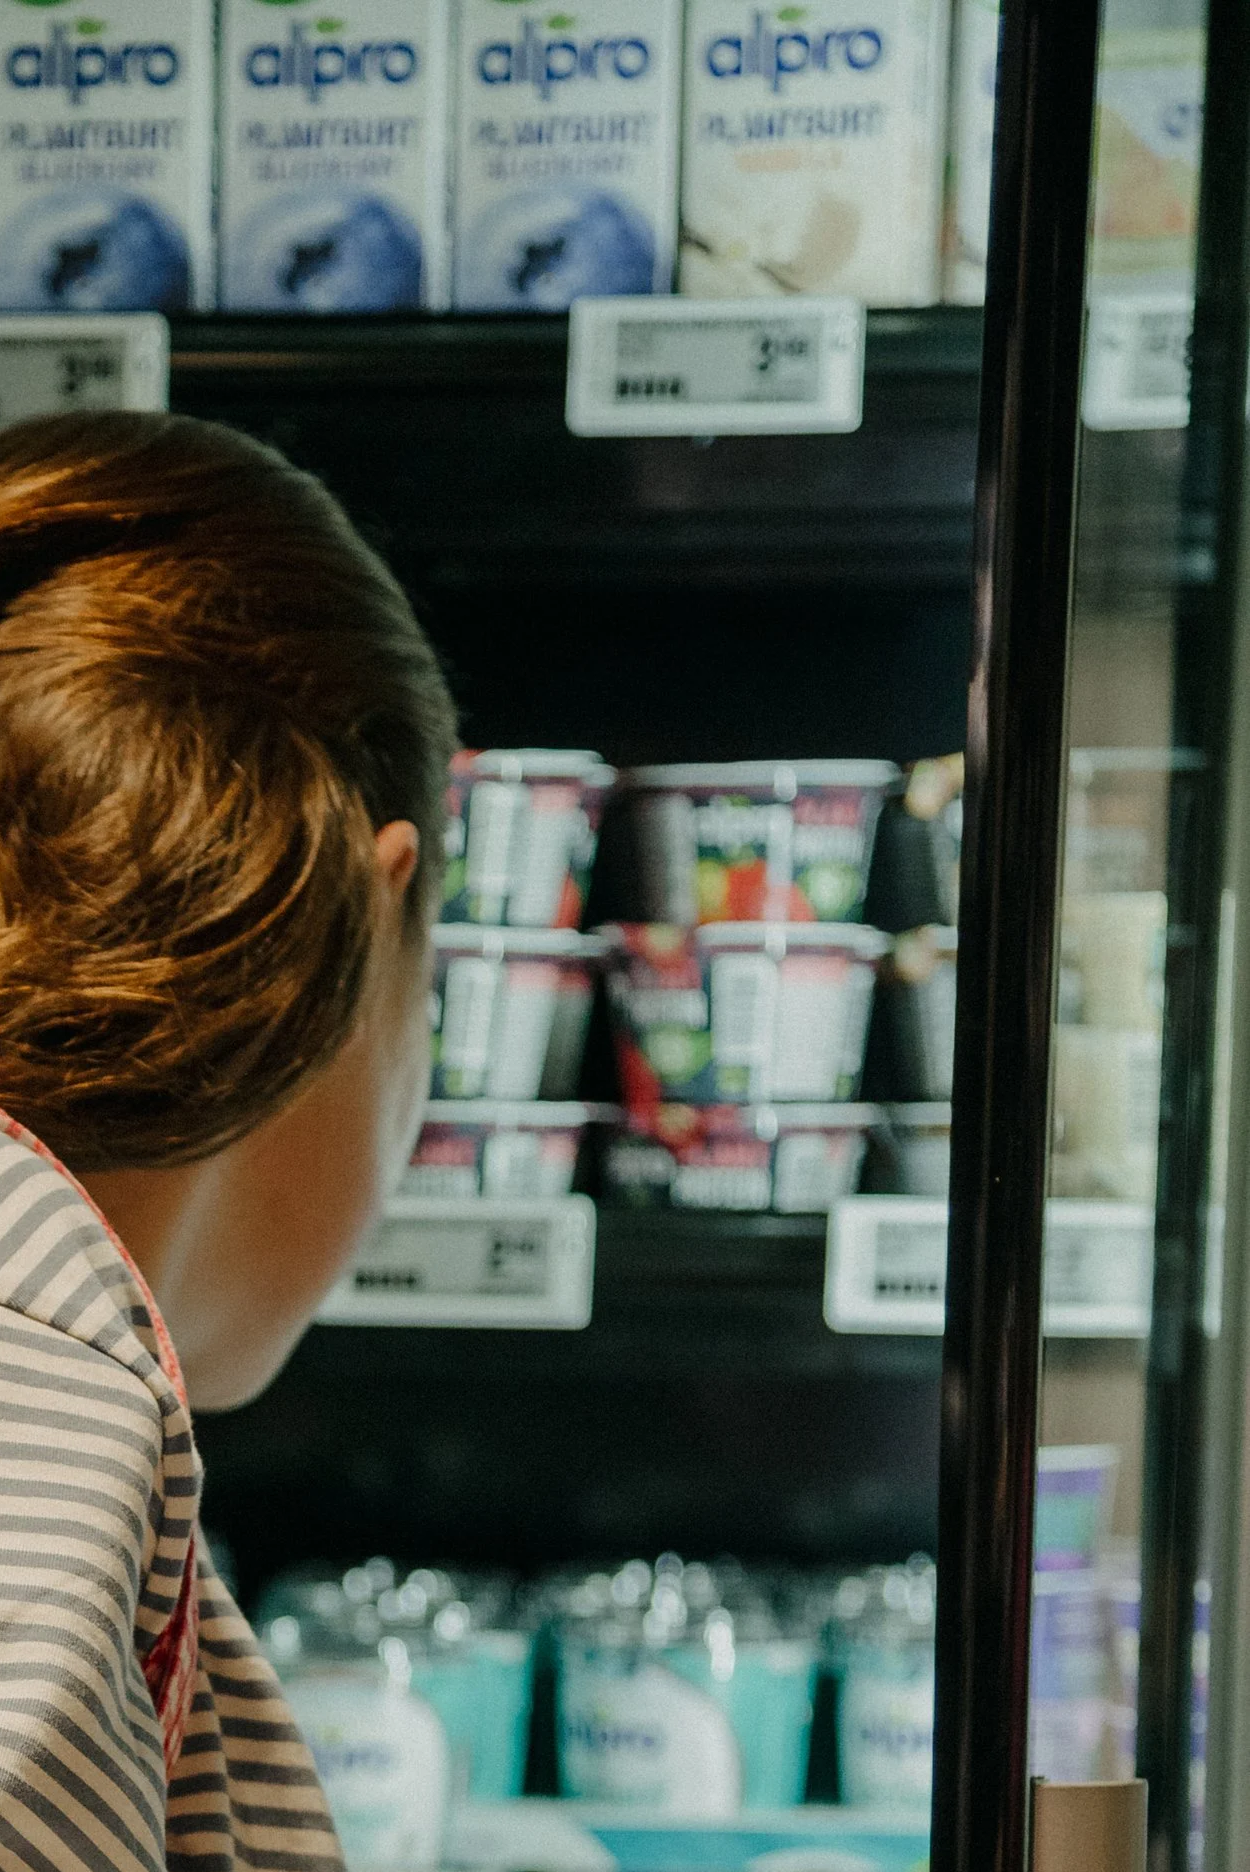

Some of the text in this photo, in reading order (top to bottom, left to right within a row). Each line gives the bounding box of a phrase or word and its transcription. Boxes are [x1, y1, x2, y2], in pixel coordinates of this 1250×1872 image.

[6, 19, 180, 106] alpro
[245, 20, 417, 104] alpro
[477, 18, 650, 102] alpro
[706, 12, 883, 93] alpro
